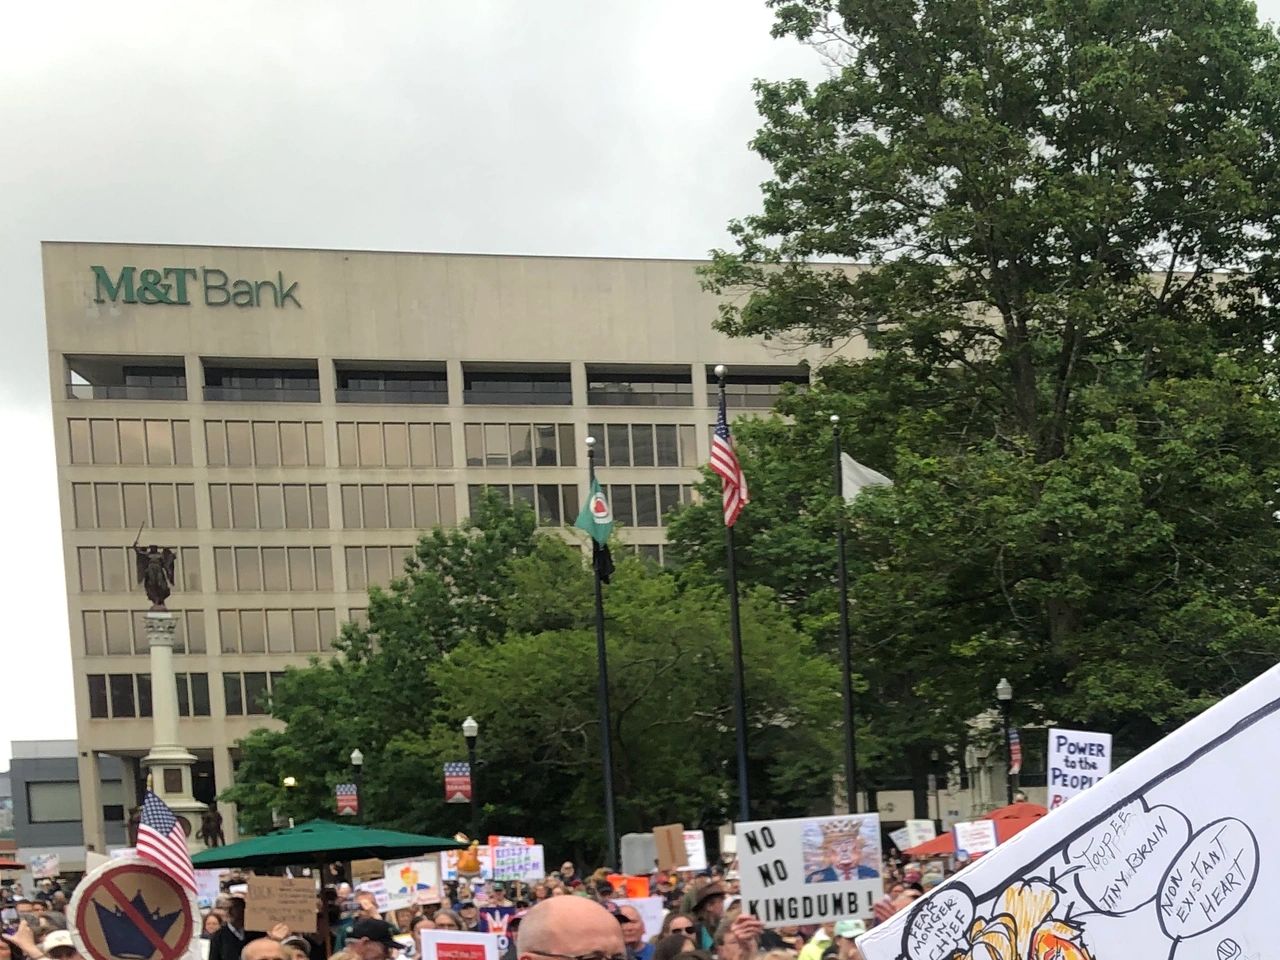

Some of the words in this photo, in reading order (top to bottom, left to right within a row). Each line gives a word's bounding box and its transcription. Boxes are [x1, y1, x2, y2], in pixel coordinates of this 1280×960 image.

[91, 265, 197, 306] M&T
[202, 267, 303, 309] Bank
[745, 825, 776, 855] NO
[758, 859, 788, 888] NO
[1099, 870, 1129, 911] TINY
[1125, 815, 1168, 874] BRAIN
[1160, 868, 1184, 917] NON
[1199, 848, 1247, 923] HEART
[909, 901, 938, 940] FEAR
[913, 898, 958, 956] MONGER
[934, 922, 947, 938] IN
